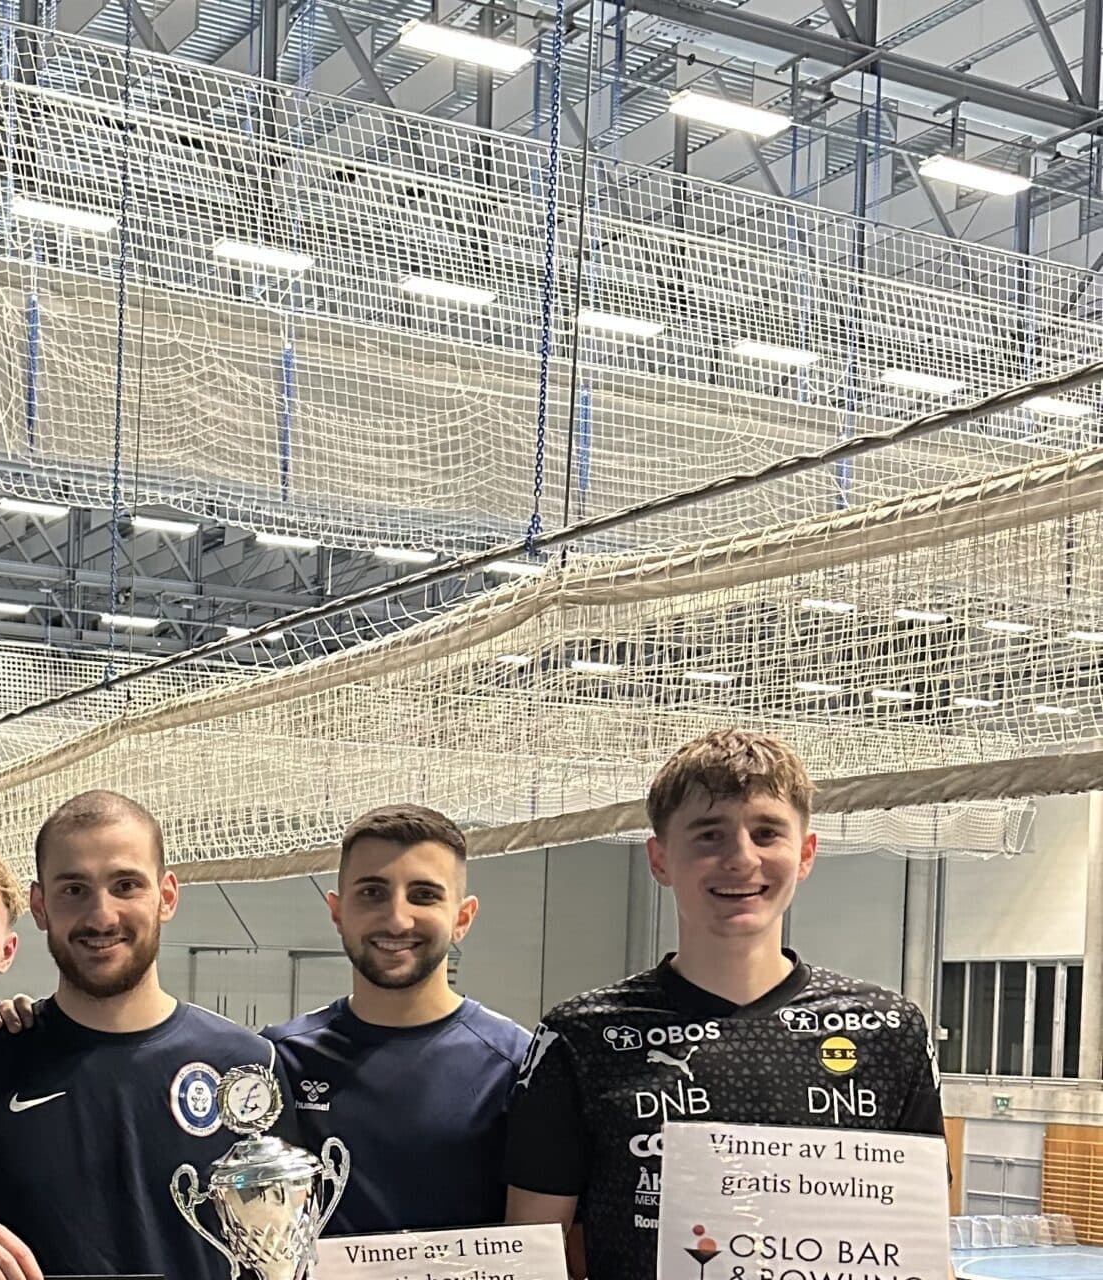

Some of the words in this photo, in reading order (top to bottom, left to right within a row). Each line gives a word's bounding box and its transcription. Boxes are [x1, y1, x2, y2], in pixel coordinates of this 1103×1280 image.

[646, 1021, 721, 1046] OBOS
[822, 1049, 856, 1058] LSK
[295, 1100, 331, 1111] hummel
[635, 1080, 711, 1121] DNB
[808, 1078, 877, 1124] DNB
[709, 1132, 793, 1157] Vinner
[799, 1143, 825, 1160] av
[834, 1141, 845, 1160] 1
[854, 1142, 905, 1164] time
[721, 1173, 791, 1196] gratis
[798, 1174, 895, 1205] bowling
[345, 1244, 418, 1264] Vinner
[424, 1244, 448, 1259] av
[456, 1239, 466, 1256] 1
[473, 1237, 523, 1256] time
[729, 1234, 822, 1262] OSLO
[838, 1240, 900, 1267] BAR
